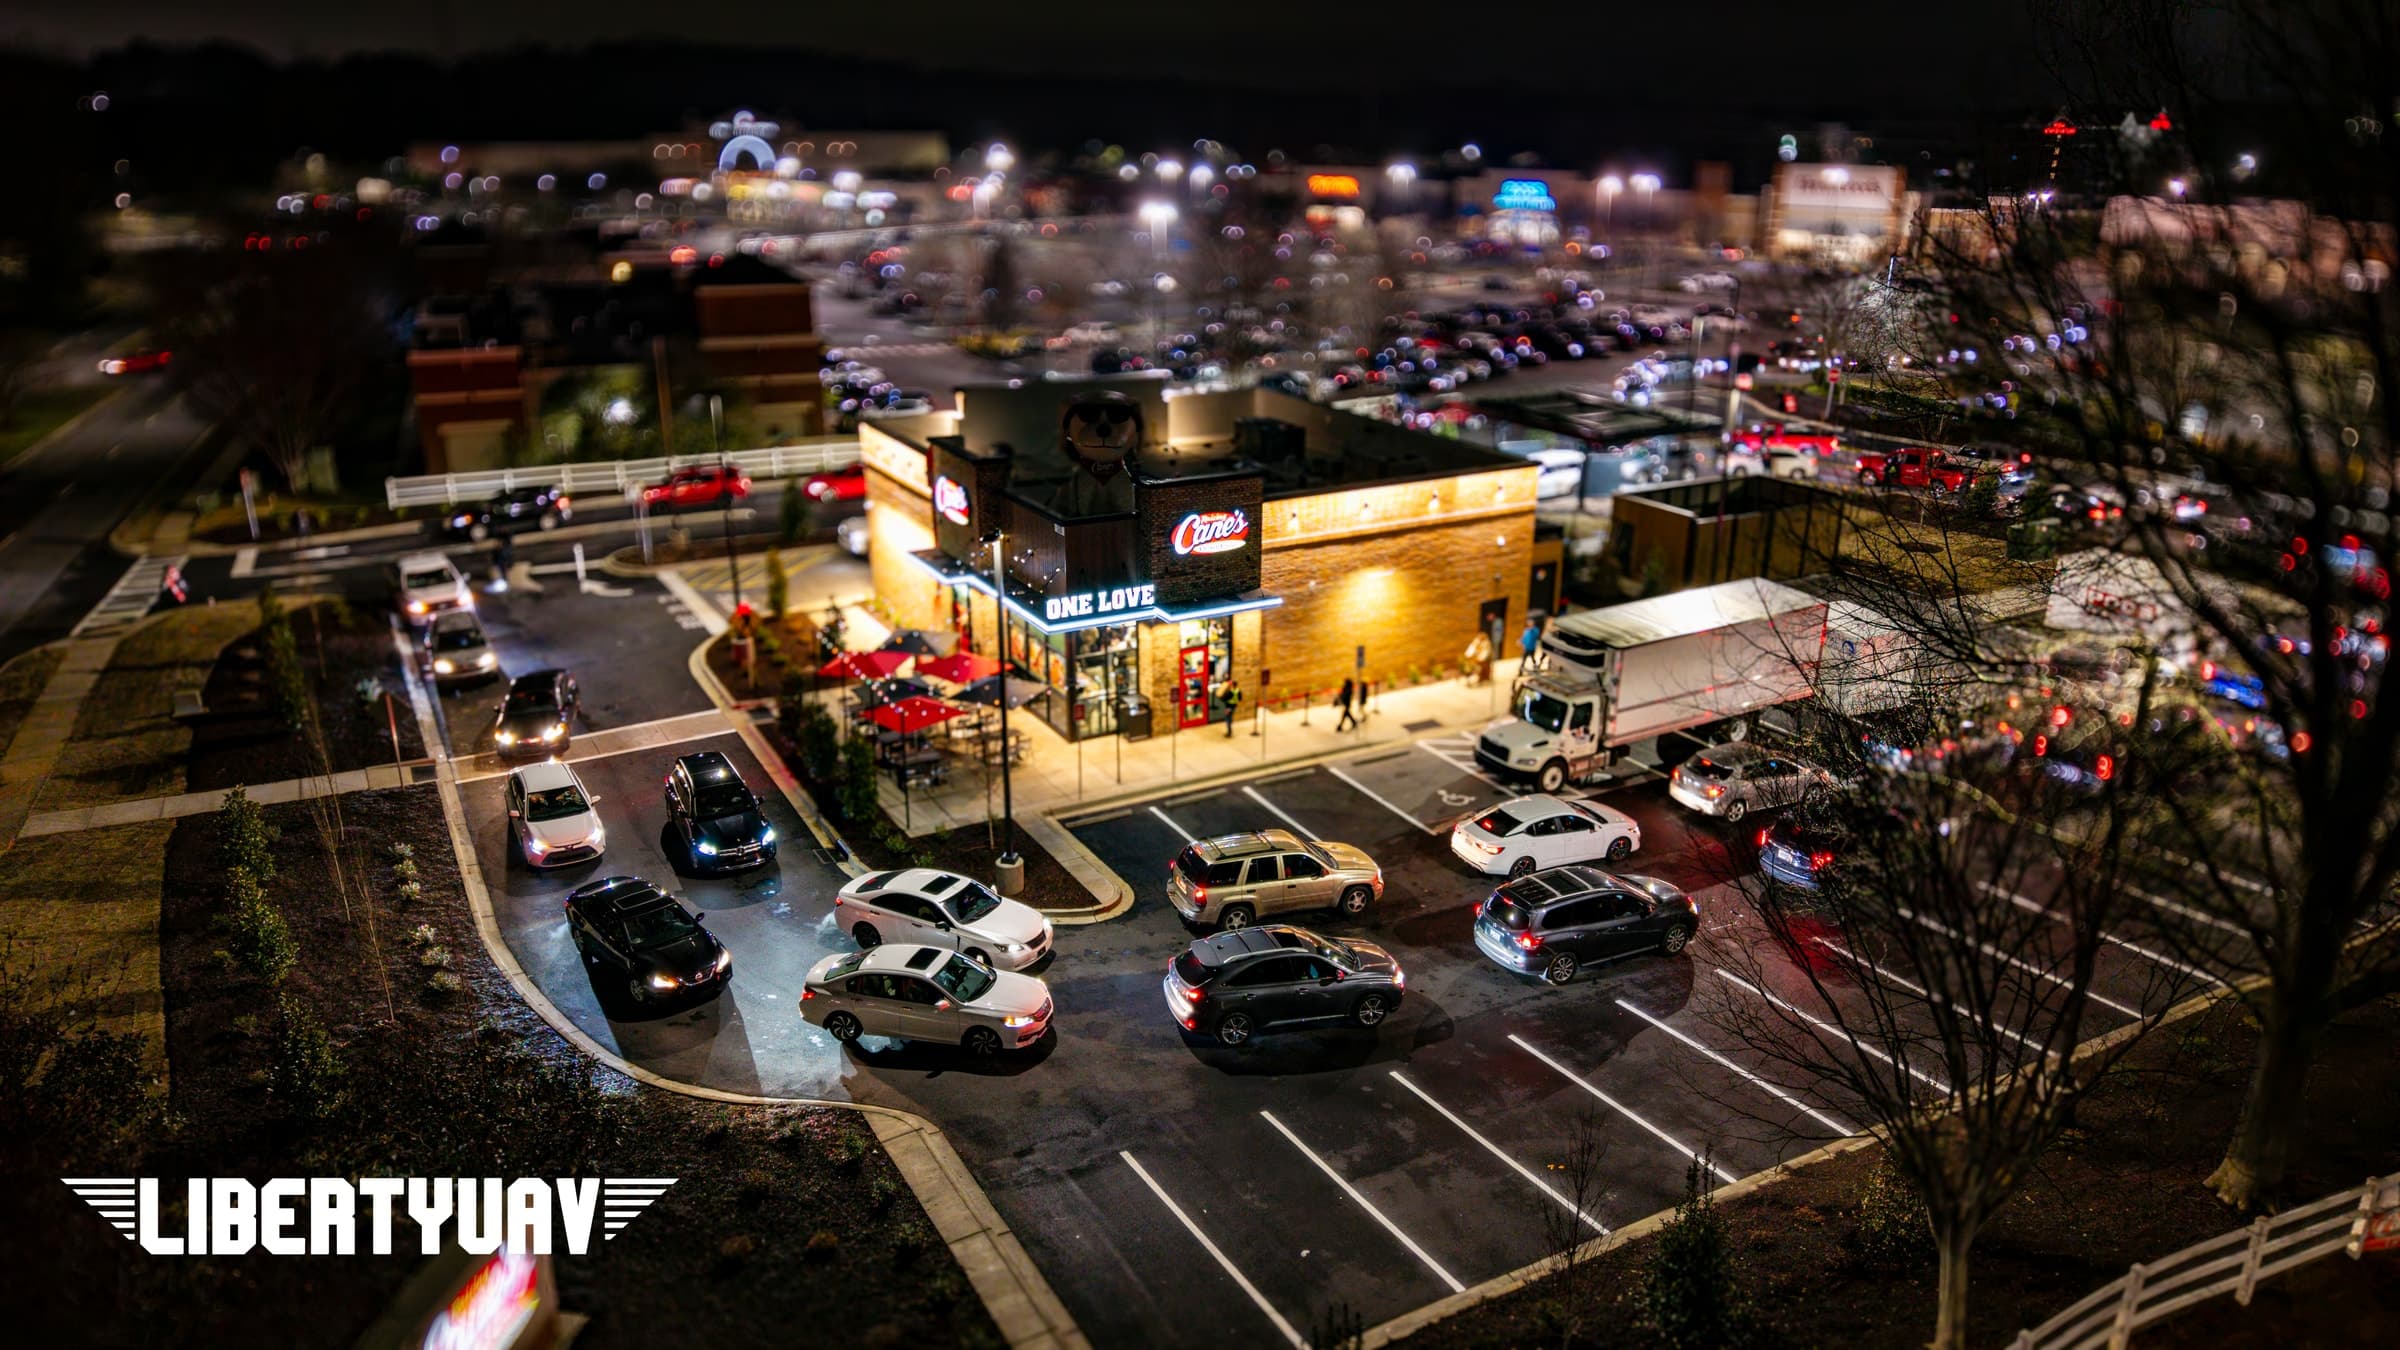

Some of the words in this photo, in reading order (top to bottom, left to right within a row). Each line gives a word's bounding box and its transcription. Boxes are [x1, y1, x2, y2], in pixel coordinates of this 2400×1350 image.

[1174, 508, 1249, 555] Cane's
[1046, 592, 1094, 621] ONE
[1097, 584, 1155, 613] LOVE
